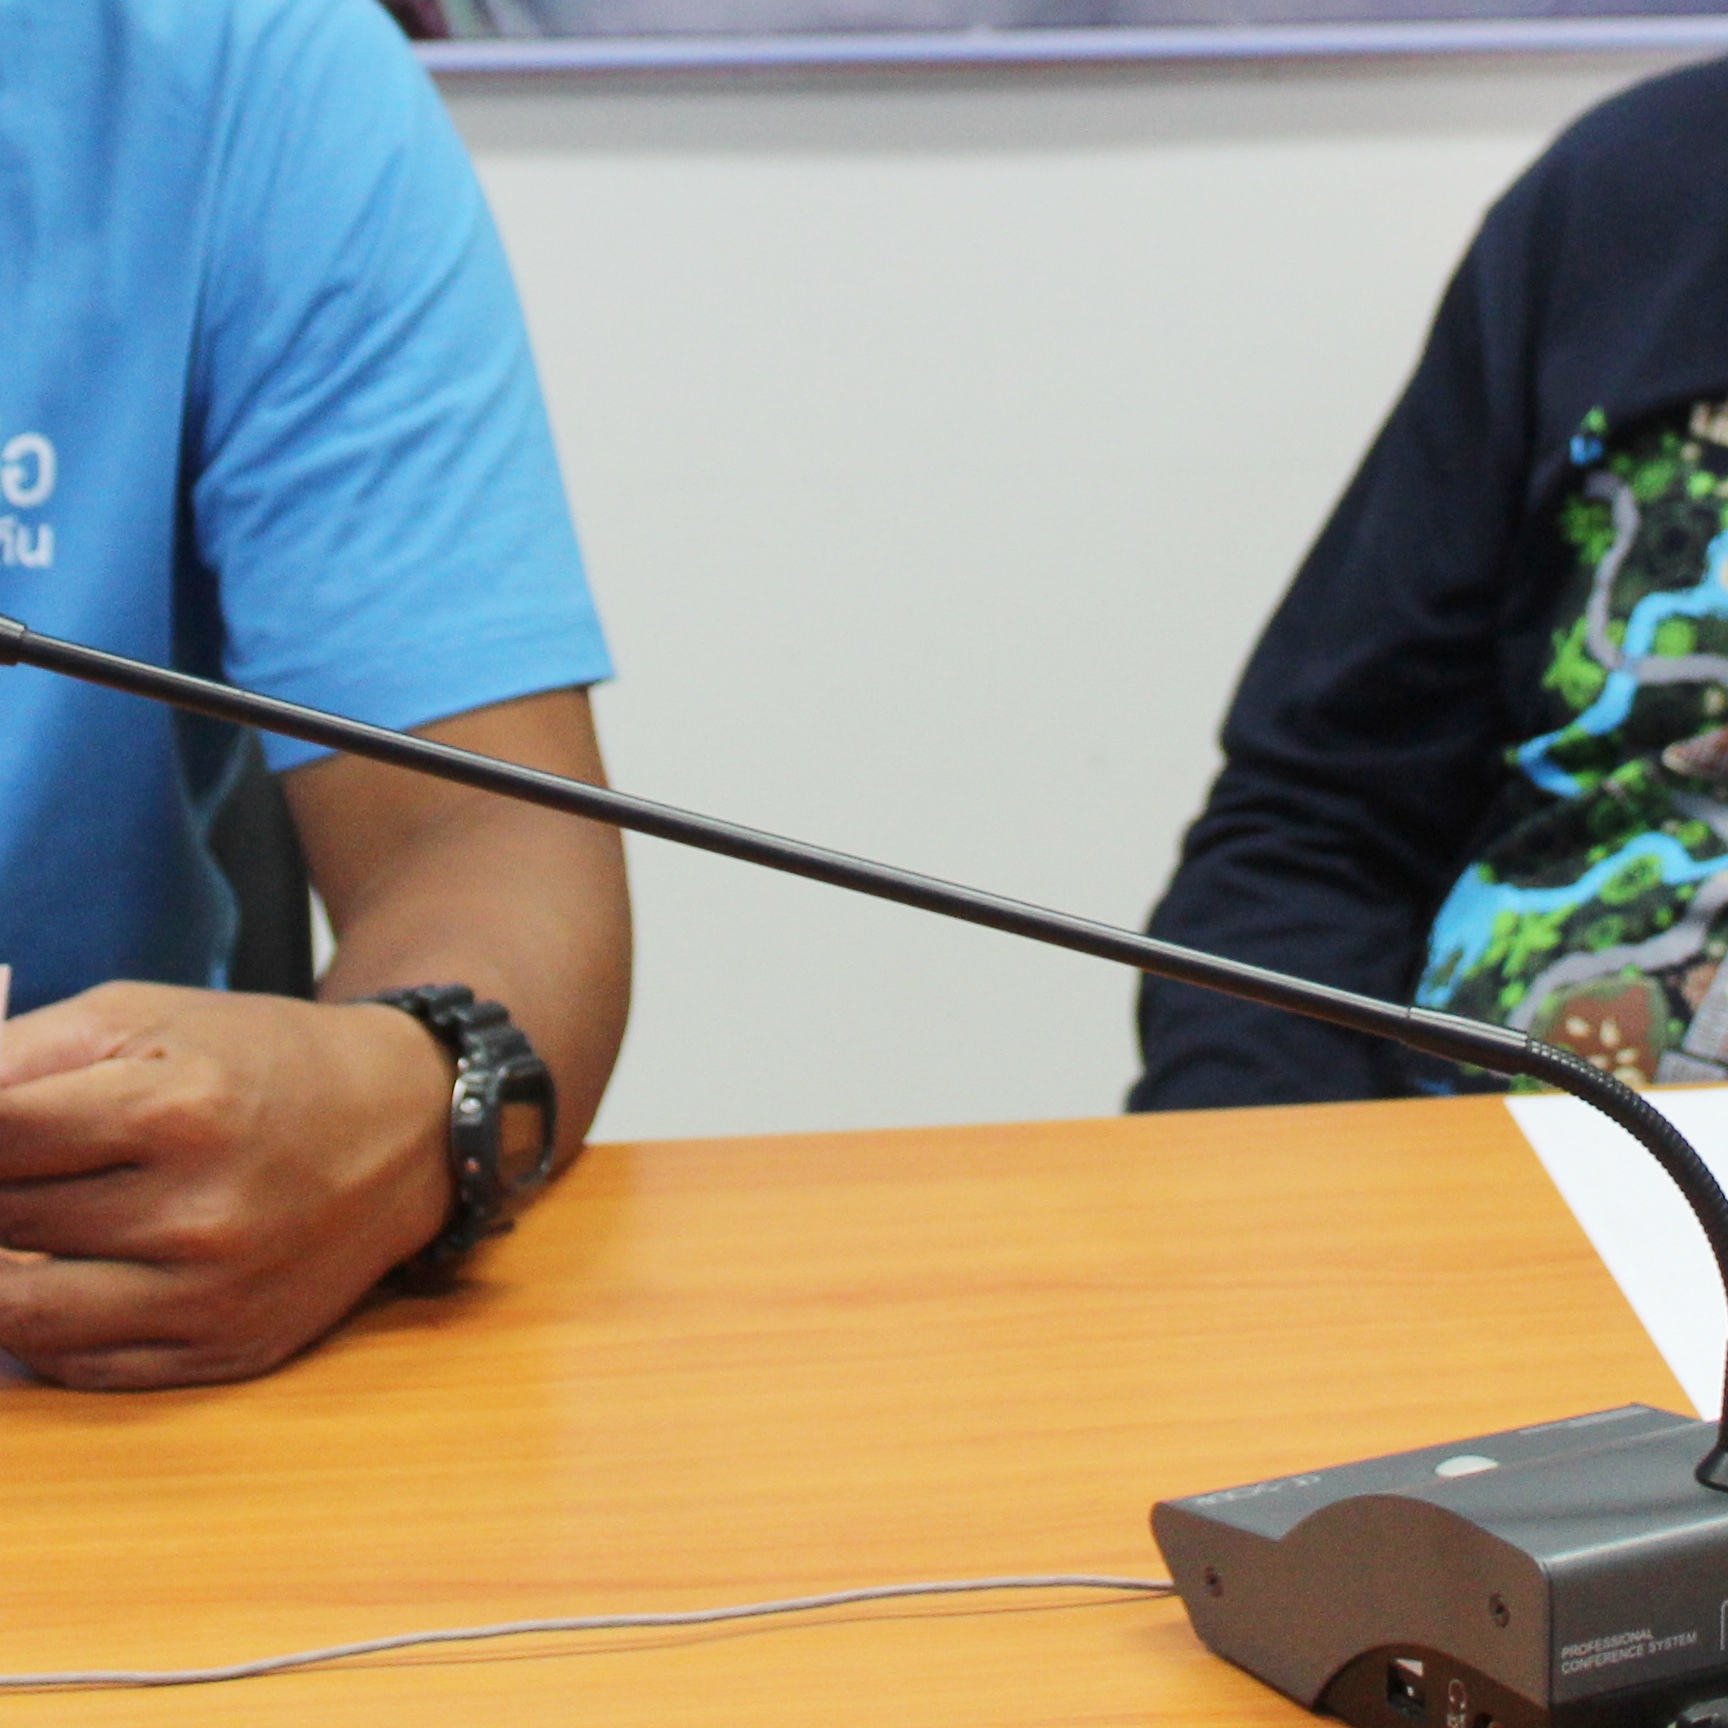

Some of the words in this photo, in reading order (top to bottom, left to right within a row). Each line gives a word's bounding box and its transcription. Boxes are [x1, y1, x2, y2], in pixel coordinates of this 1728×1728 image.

[1561, 1626, 1654, 1660] PROFESSIONAL
[1561, 1643, 1645, 1675] CONFERENCE
[1648, 1629, 1699, 1656] SYSTEM
